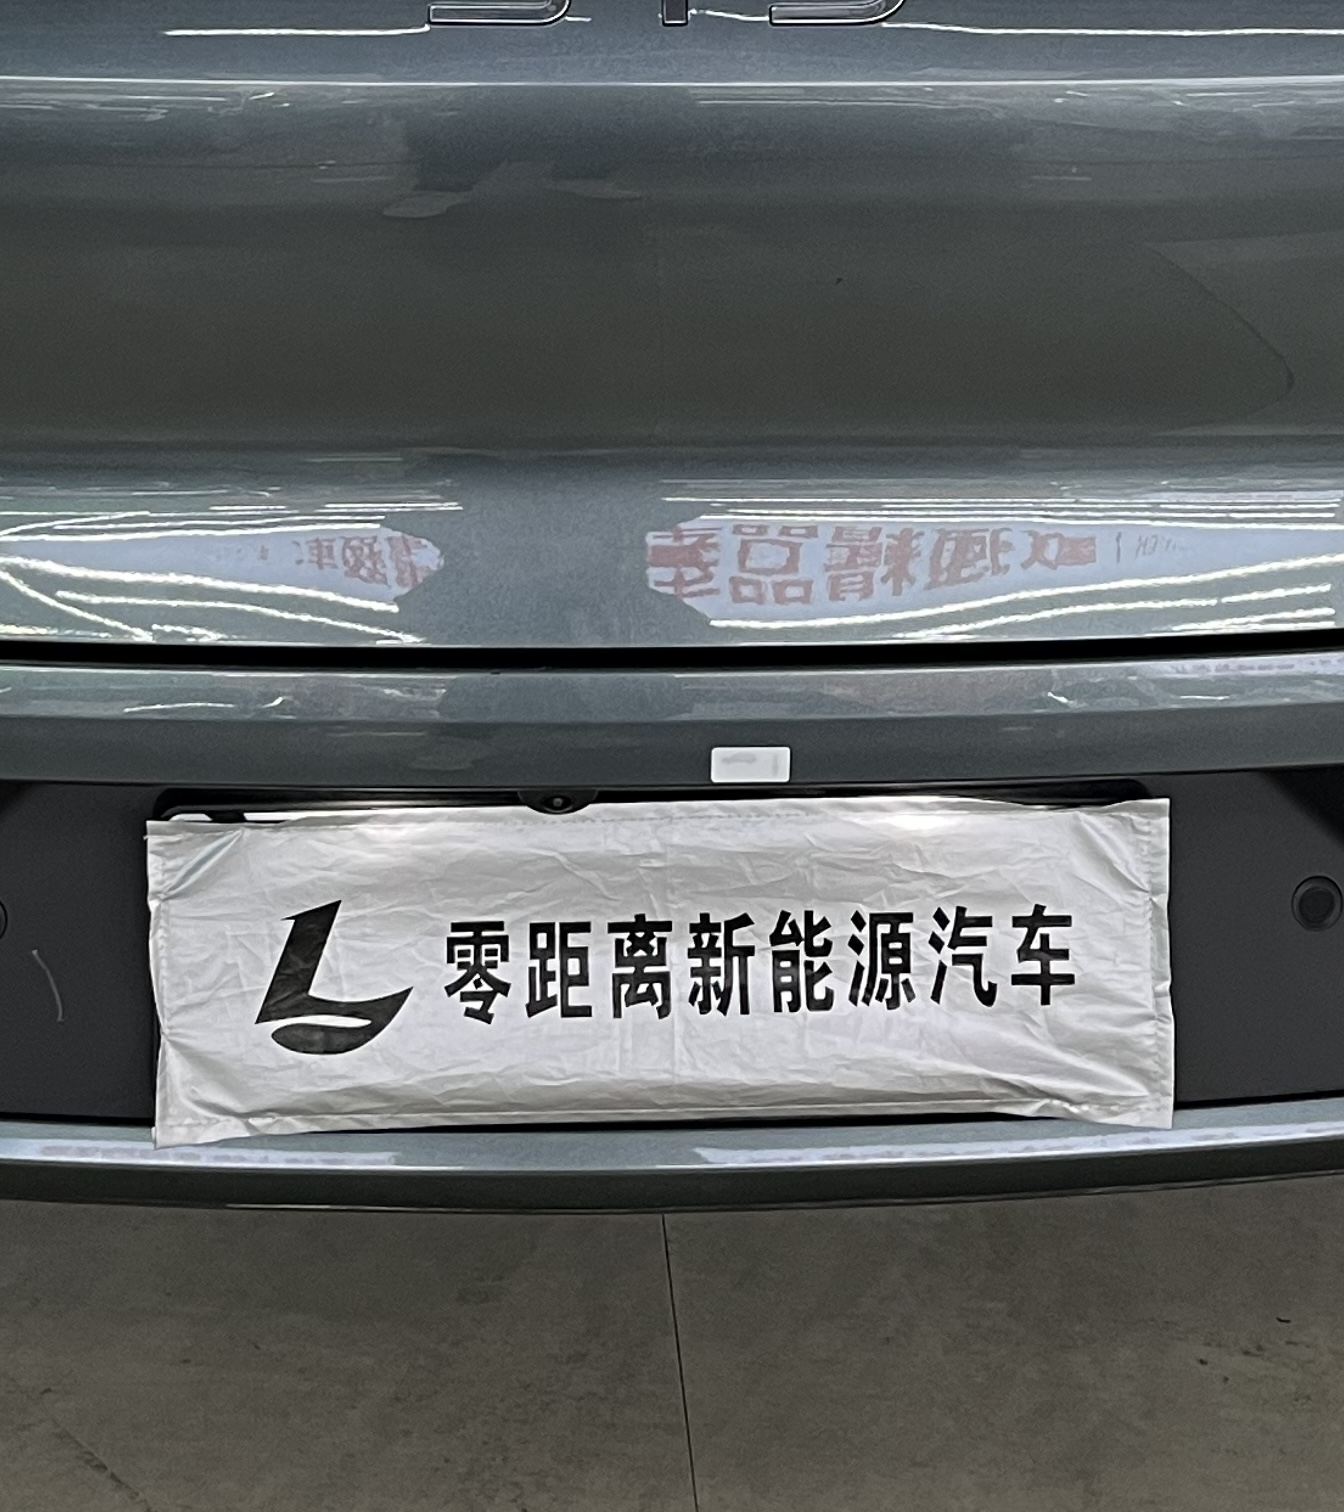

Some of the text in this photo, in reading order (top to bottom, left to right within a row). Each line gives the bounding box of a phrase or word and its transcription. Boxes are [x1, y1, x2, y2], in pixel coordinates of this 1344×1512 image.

[443, 902, 1077, 1026] 零距离新能源汽车
